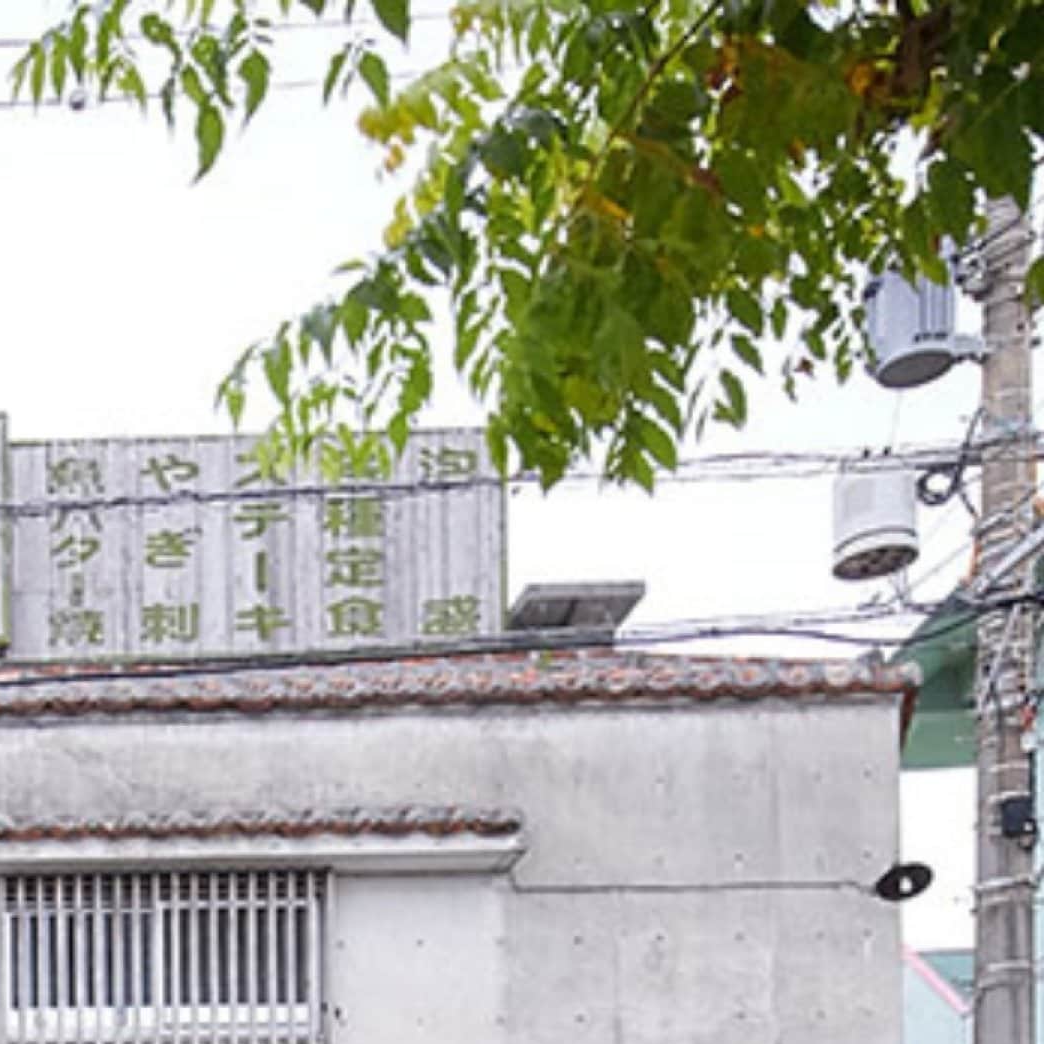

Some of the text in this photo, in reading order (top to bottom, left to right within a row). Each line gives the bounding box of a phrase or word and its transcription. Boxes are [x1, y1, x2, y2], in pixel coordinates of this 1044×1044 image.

[140, 455, 203, 644] やぎ刺
[324, 447, 387, 639] 種定食
